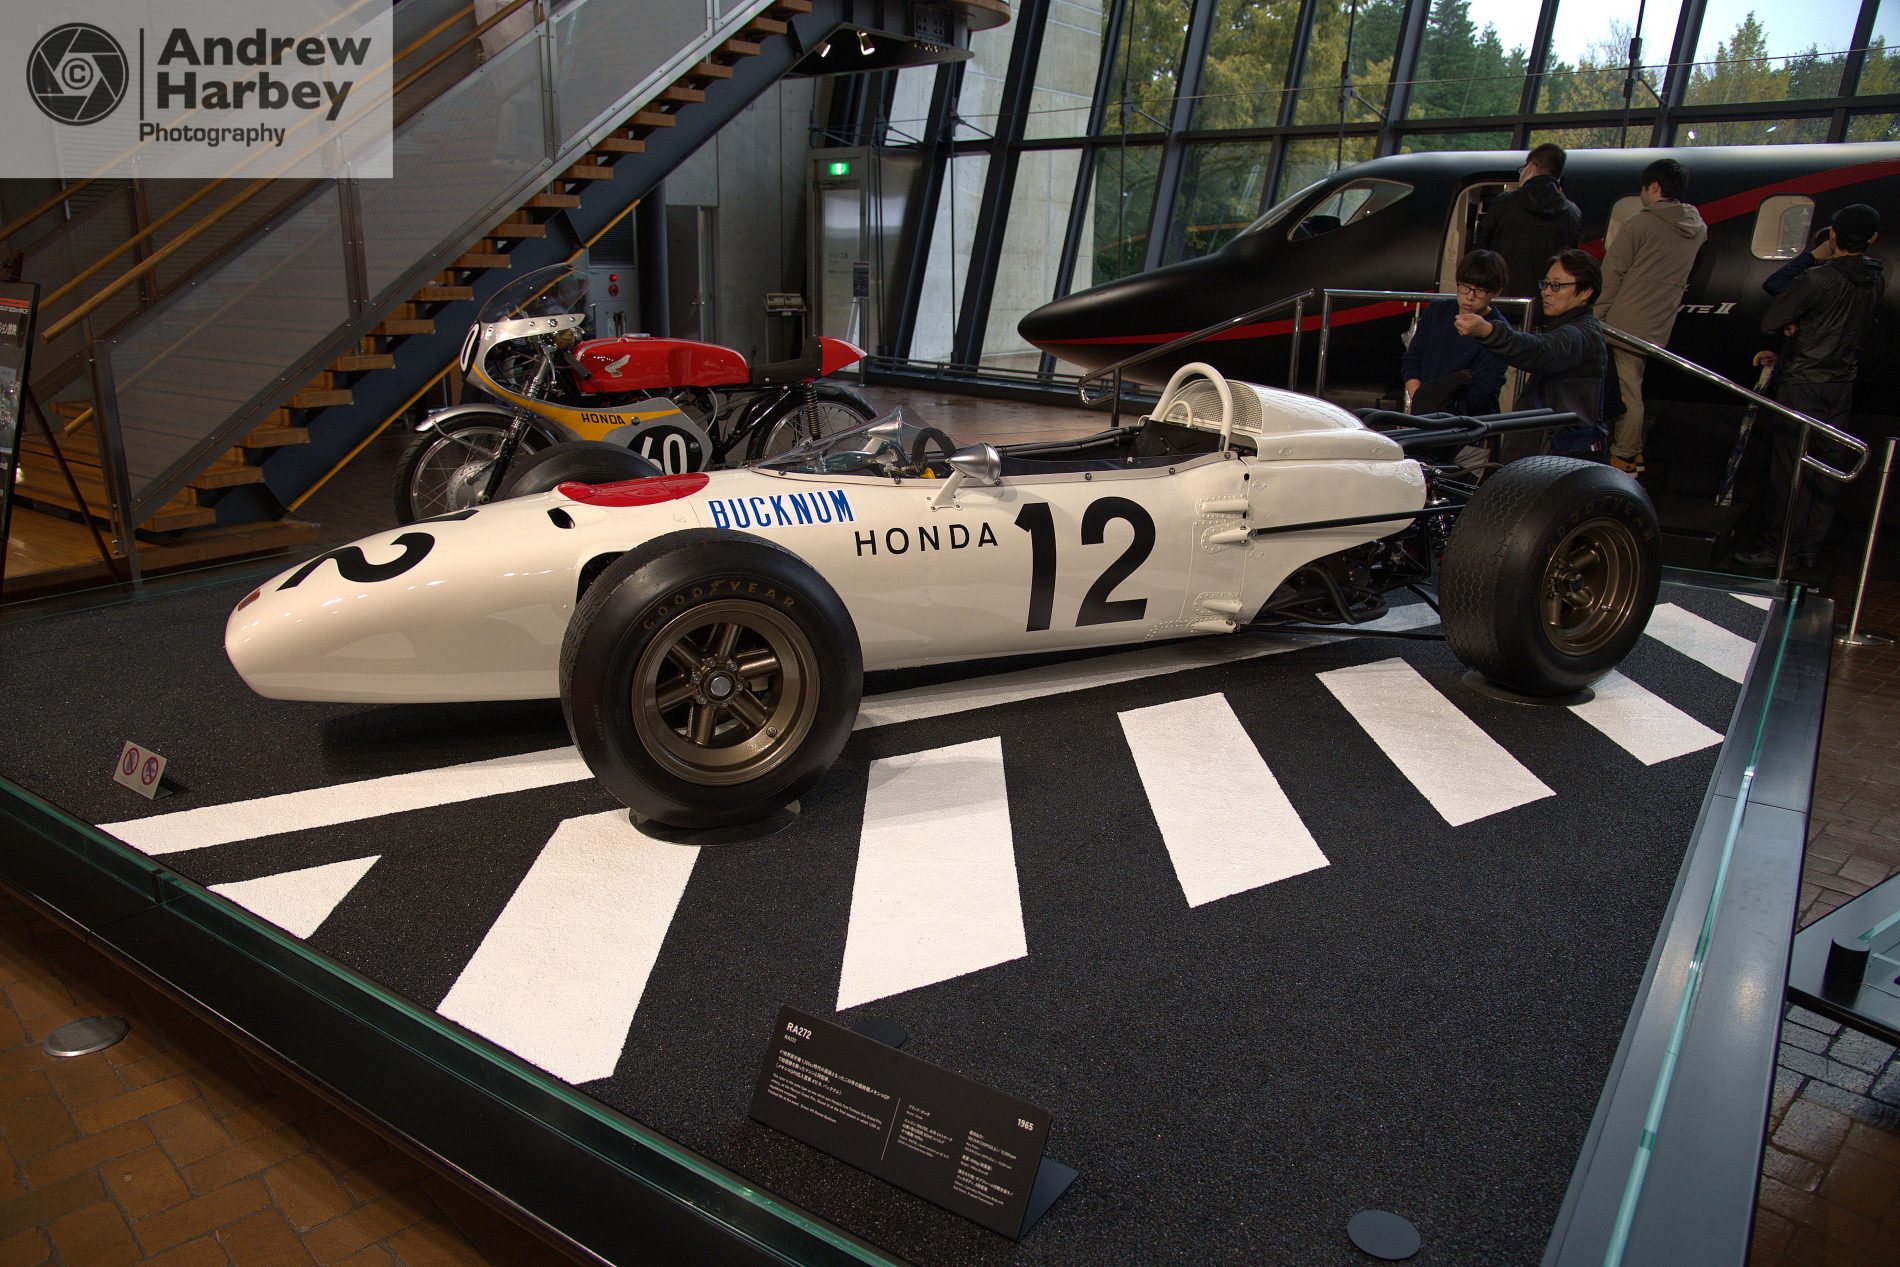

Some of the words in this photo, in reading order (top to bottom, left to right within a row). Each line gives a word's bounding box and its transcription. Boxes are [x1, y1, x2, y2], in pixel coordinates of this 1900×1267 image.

[581, 413, 626, 425] HONDA
[708, 489, 855, 530] BUCKNUM
[854, 522, 999, 557] HONDA
[1014, 496, 1157, 633] 12
[786, 1021, 813, 1040] RA272
[1016, 1117, 1036, 1132] 1965
